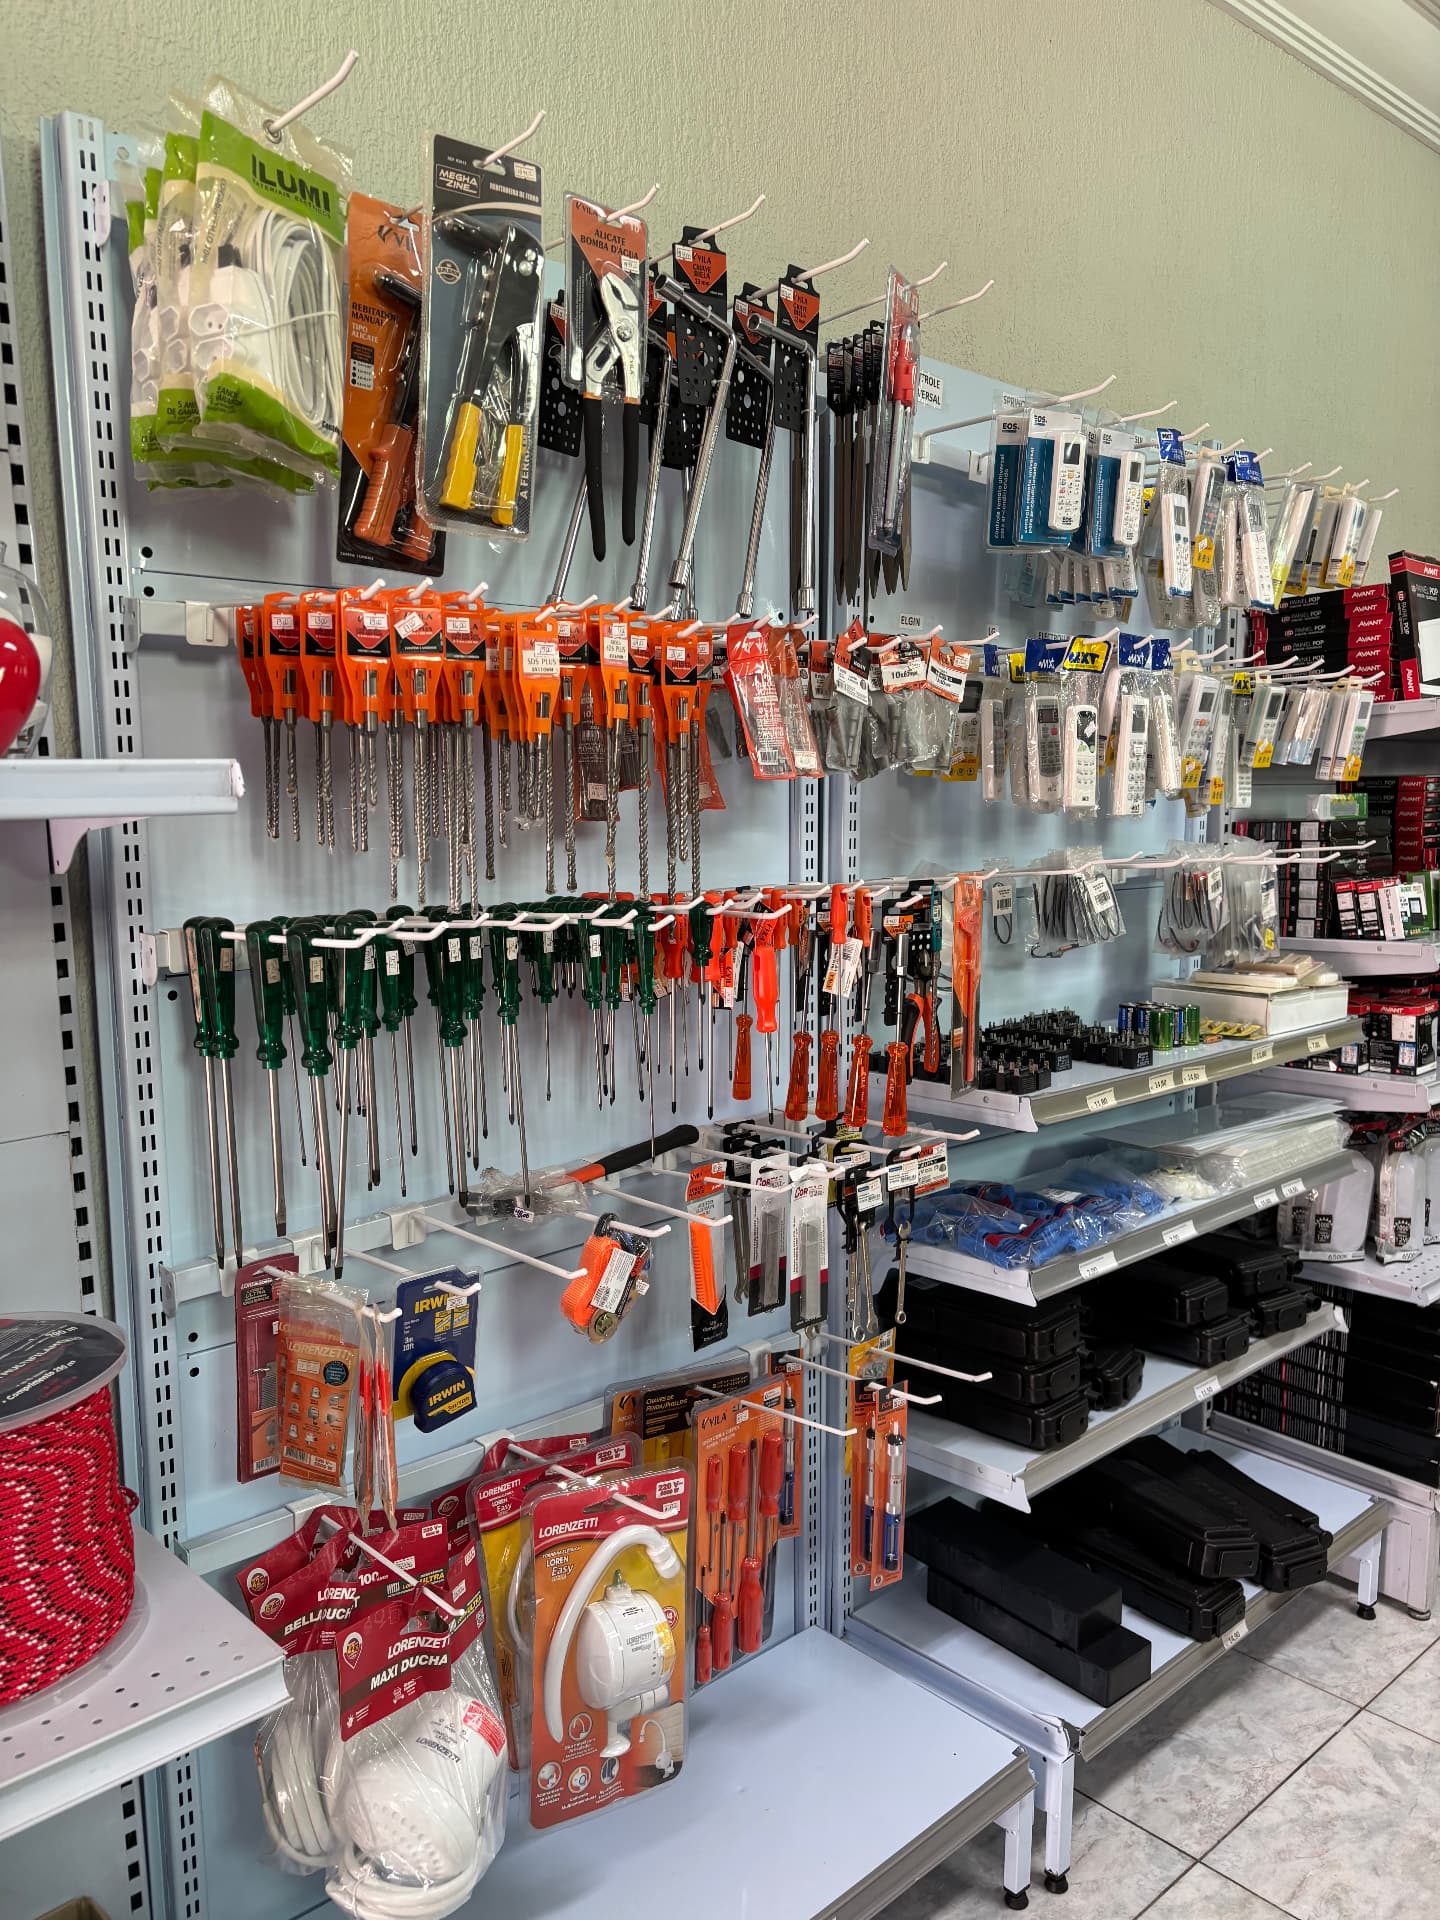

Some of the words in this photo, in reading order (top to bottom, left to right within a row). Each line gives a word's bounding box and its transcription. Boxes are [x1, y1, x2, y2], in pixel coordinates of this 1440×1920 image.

[252, 154, 331, 213] ILUMI
[439, 169, 478, 185] MEGHA
[446, 179, 471, 192] ZINE
[580, 235, 608, 252] BOMBA
[594, 229, 625, 246] ALICATE
[697, 256, 712, 265] VILA
[918, 389, 941, 406] VERSAL
[1352, 589, 1376, 599] AVANT
[1353, 604, 1377, 613] AVANT
[901, 615, 921, 627] ELGIN
[1357, 619, 1383, 628] AVANT
[1356, 635, 1381, 643] AVANT
[541, 656, 557, 665] PLUS
[1068, 652, 1100, 665] MXT
[1356, 650, 1381, 658] AVANT
[1356, 665, 1381, 673] AVANT
[1406, 668, 1415, 693] AVANT
[1380, 1005, 1404, 1015] AVANT
[289, 1341, 353, 1361] LORENZETTI
[428, 1380, 465, 1407] IRWIN
[709, 1412, 727, 1427] VILA
[480, 1479, 521, 1500] LORENZETTI
[657, 1482, 672, 1492] 220
[496, 1503, 512, 1513] Easy
[539, 1517, 598, 1539] LORENZETTI
[546, 1556, 568, 1568] LOREN
[552, 1564, 574, 1576] Easy
[388, 1635, 450, 1660] LORENZETT
[370, 1664, 398, 1691] MAXI
[401, 1654, 448, 1673] DUCHA
